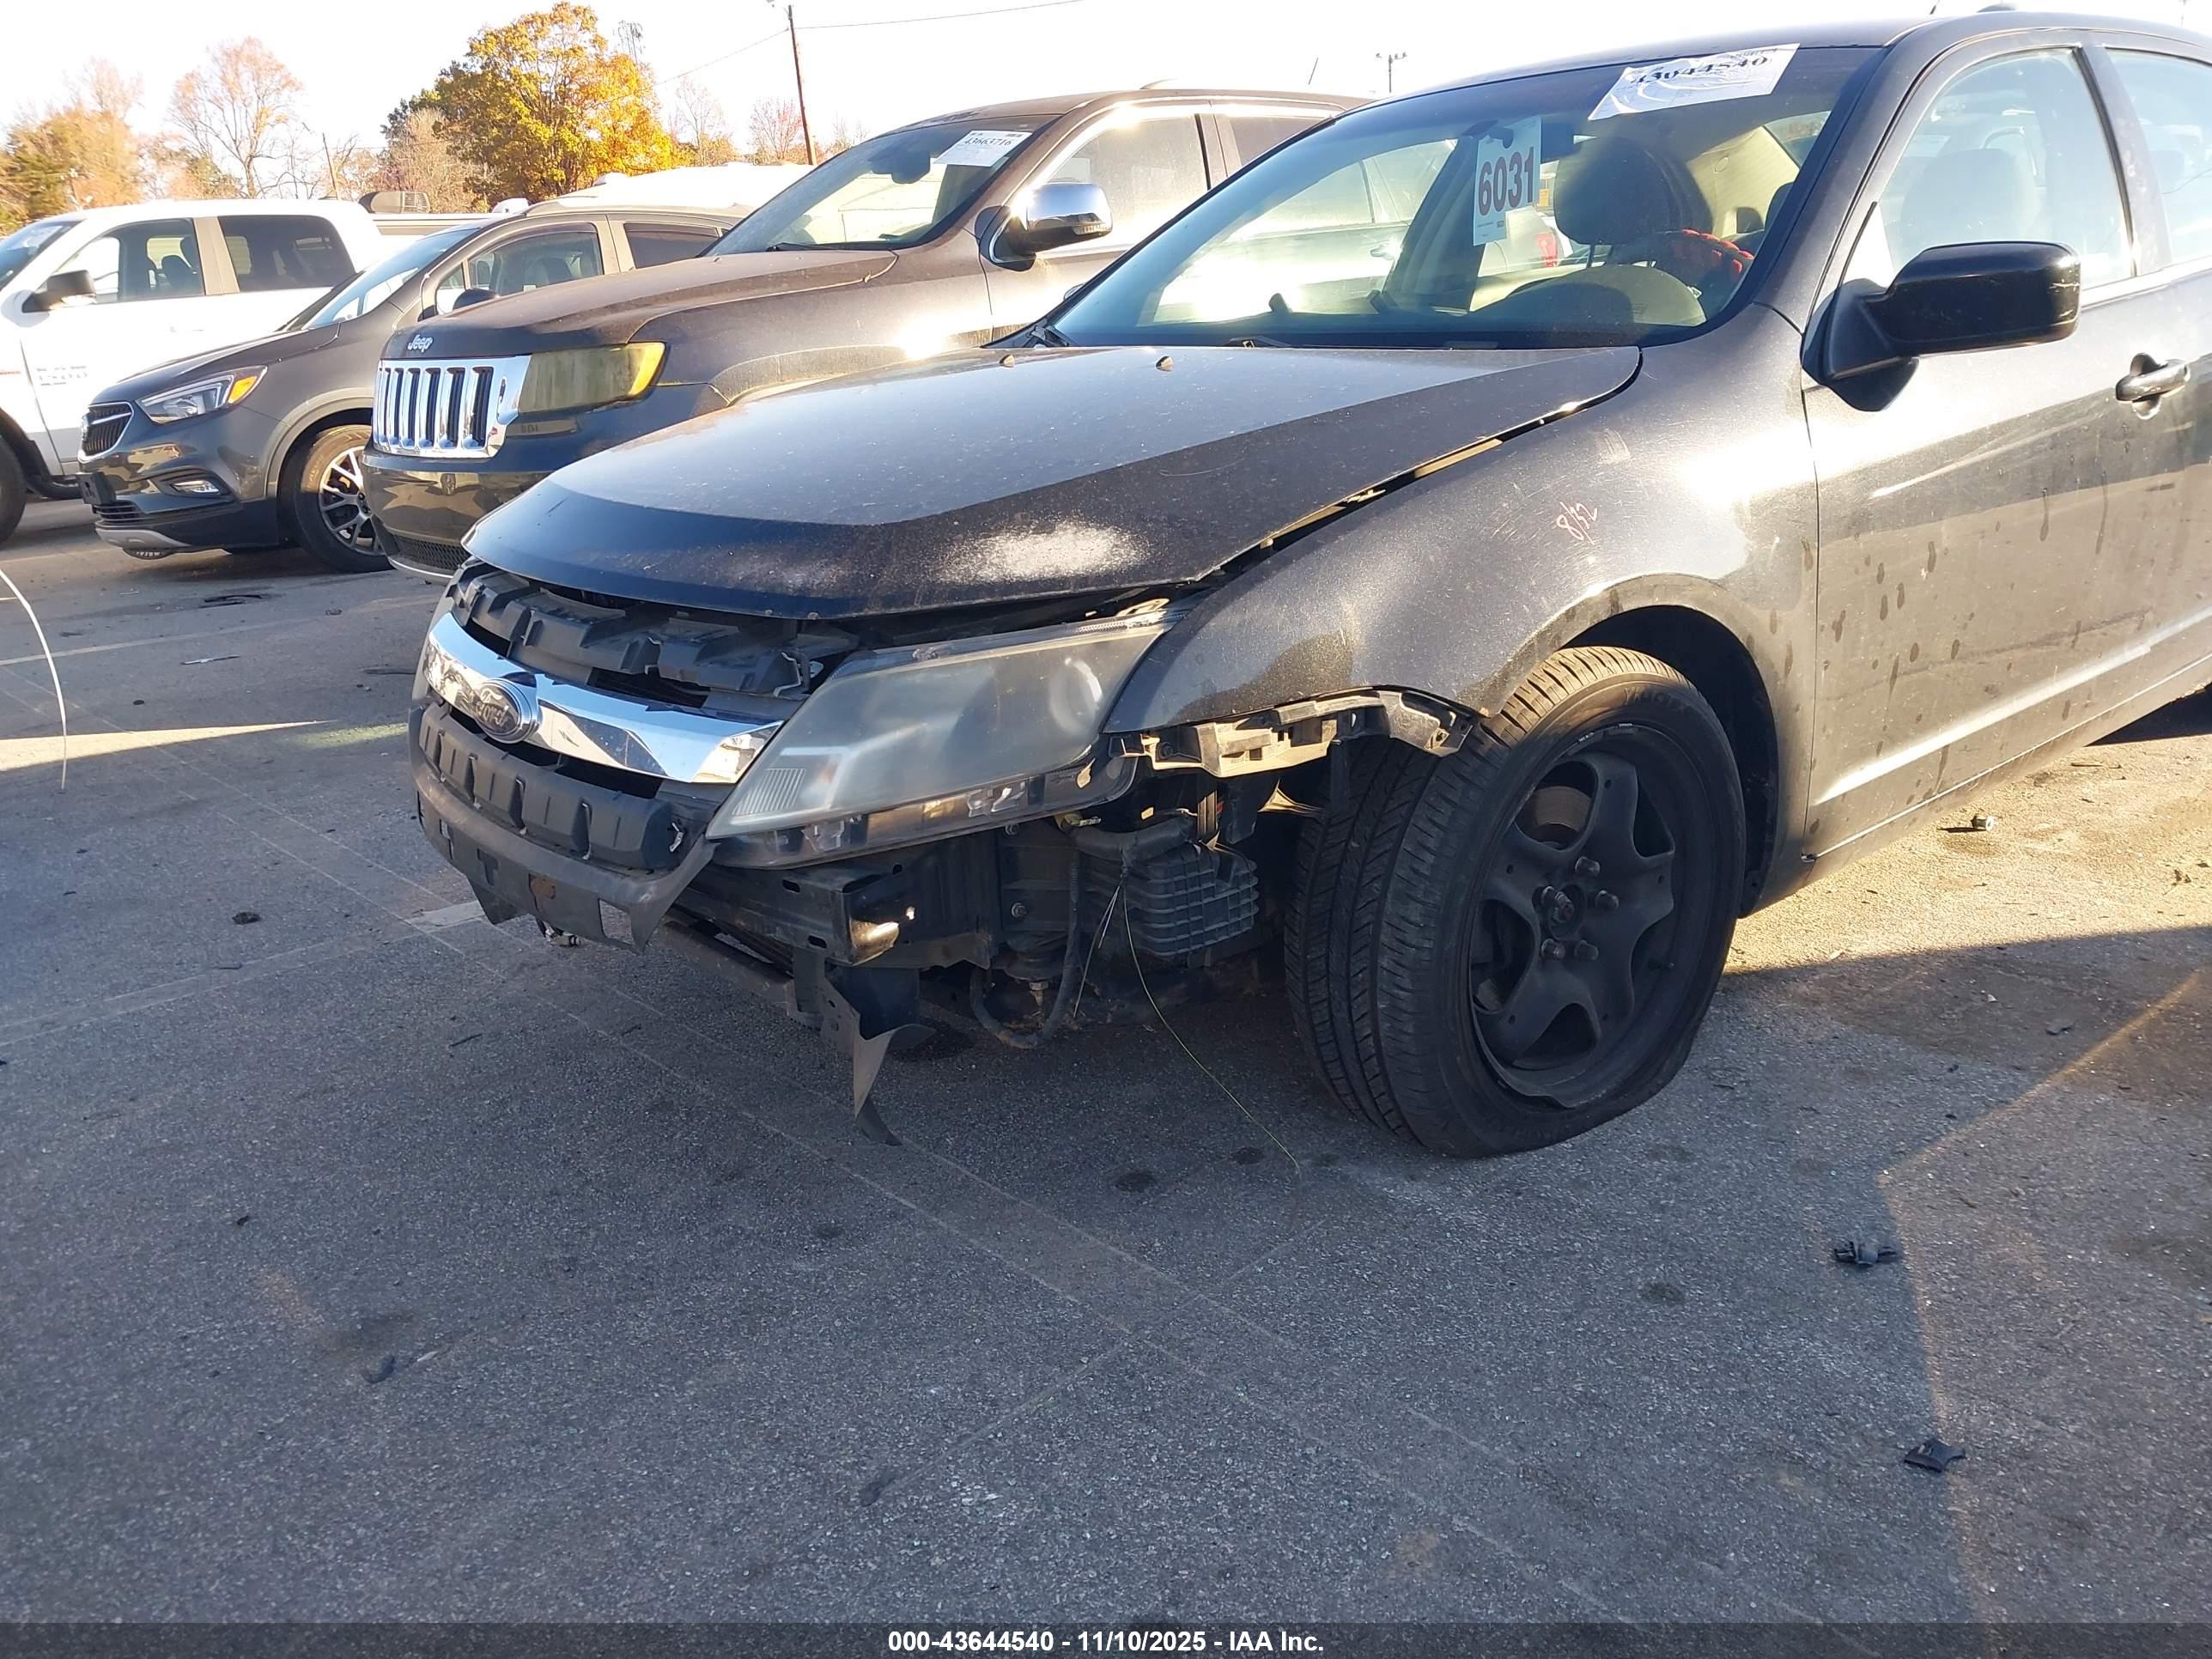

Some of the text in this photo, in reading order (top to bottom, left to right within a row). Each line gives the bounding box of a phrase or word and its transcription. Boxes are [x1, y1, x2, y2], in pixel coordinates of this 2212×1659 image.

[1478, 146, 1534, 216] 6031
[407, 334, 434, 353] Jeep
[475, 687, 509, 727] Ford
